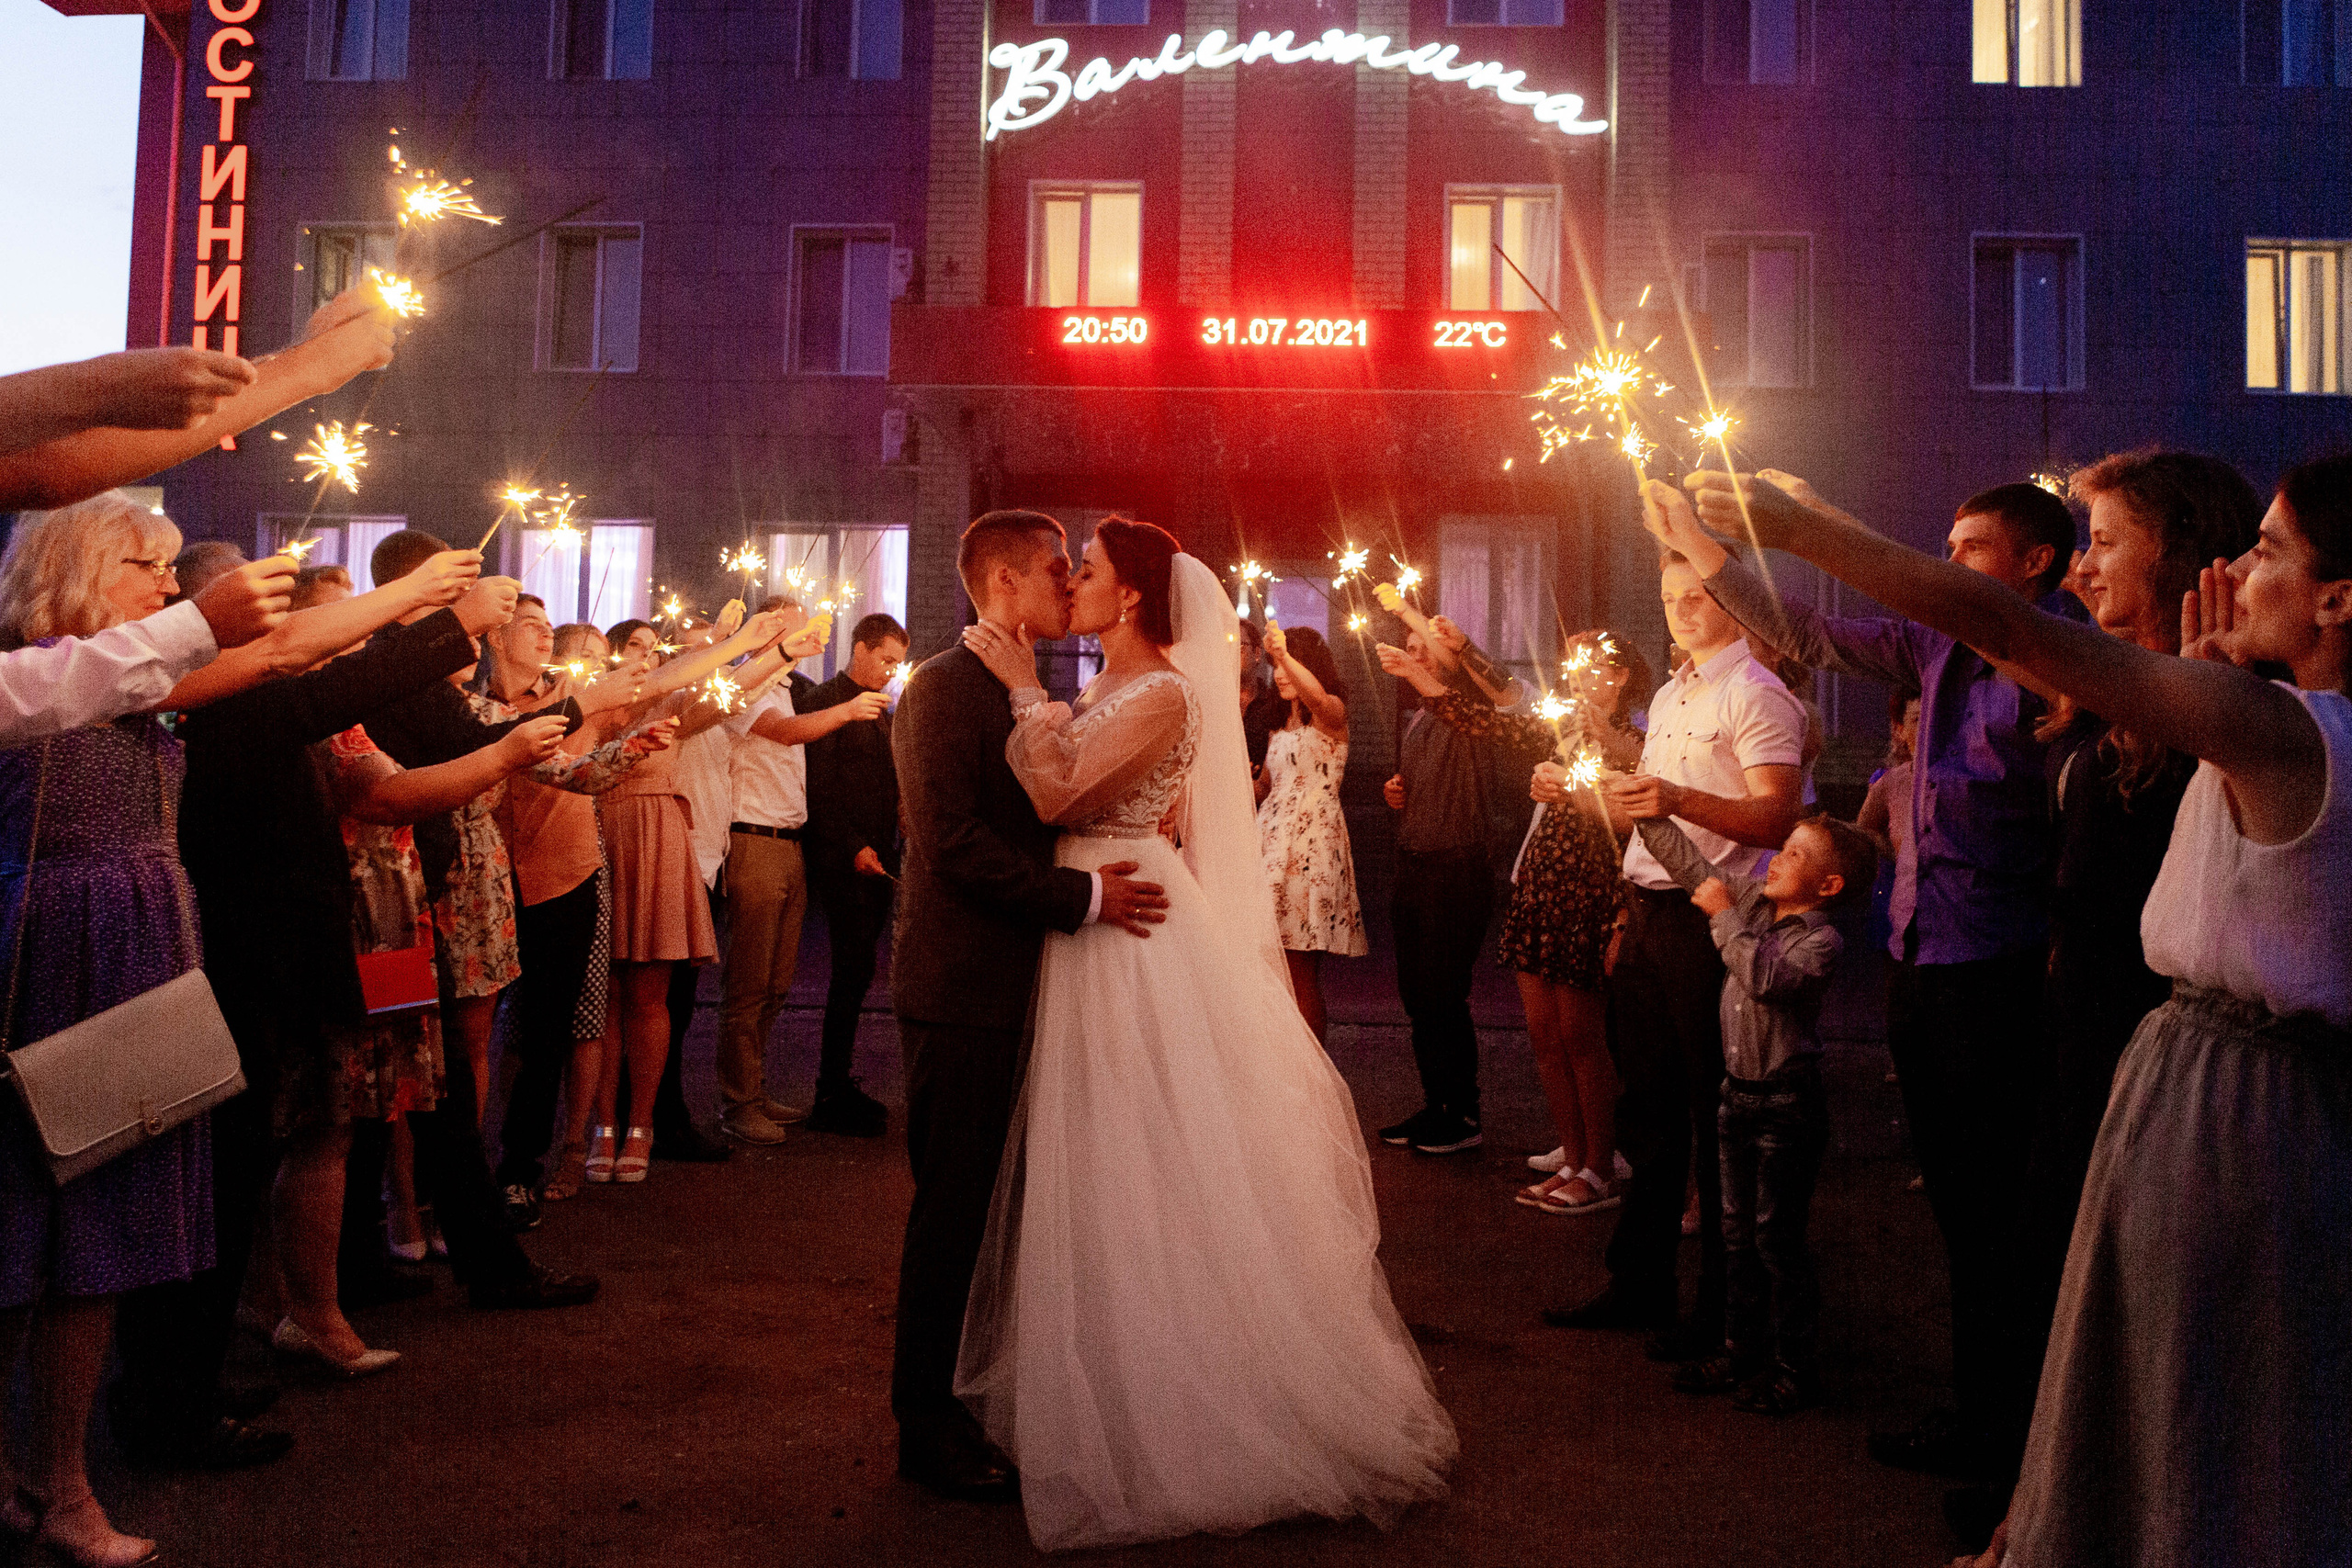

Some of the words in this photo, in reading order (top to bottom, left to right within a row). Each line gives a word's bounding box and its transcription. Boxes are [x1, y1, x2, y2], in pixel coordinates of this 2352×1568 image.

[986, 28, 1608, 141] Валентина
[192, 0, 262, 451] СТИНИ
[1062, 315, 1148, 345] 20:50
[1201, 316, 1369, 348] 31.07.2021
